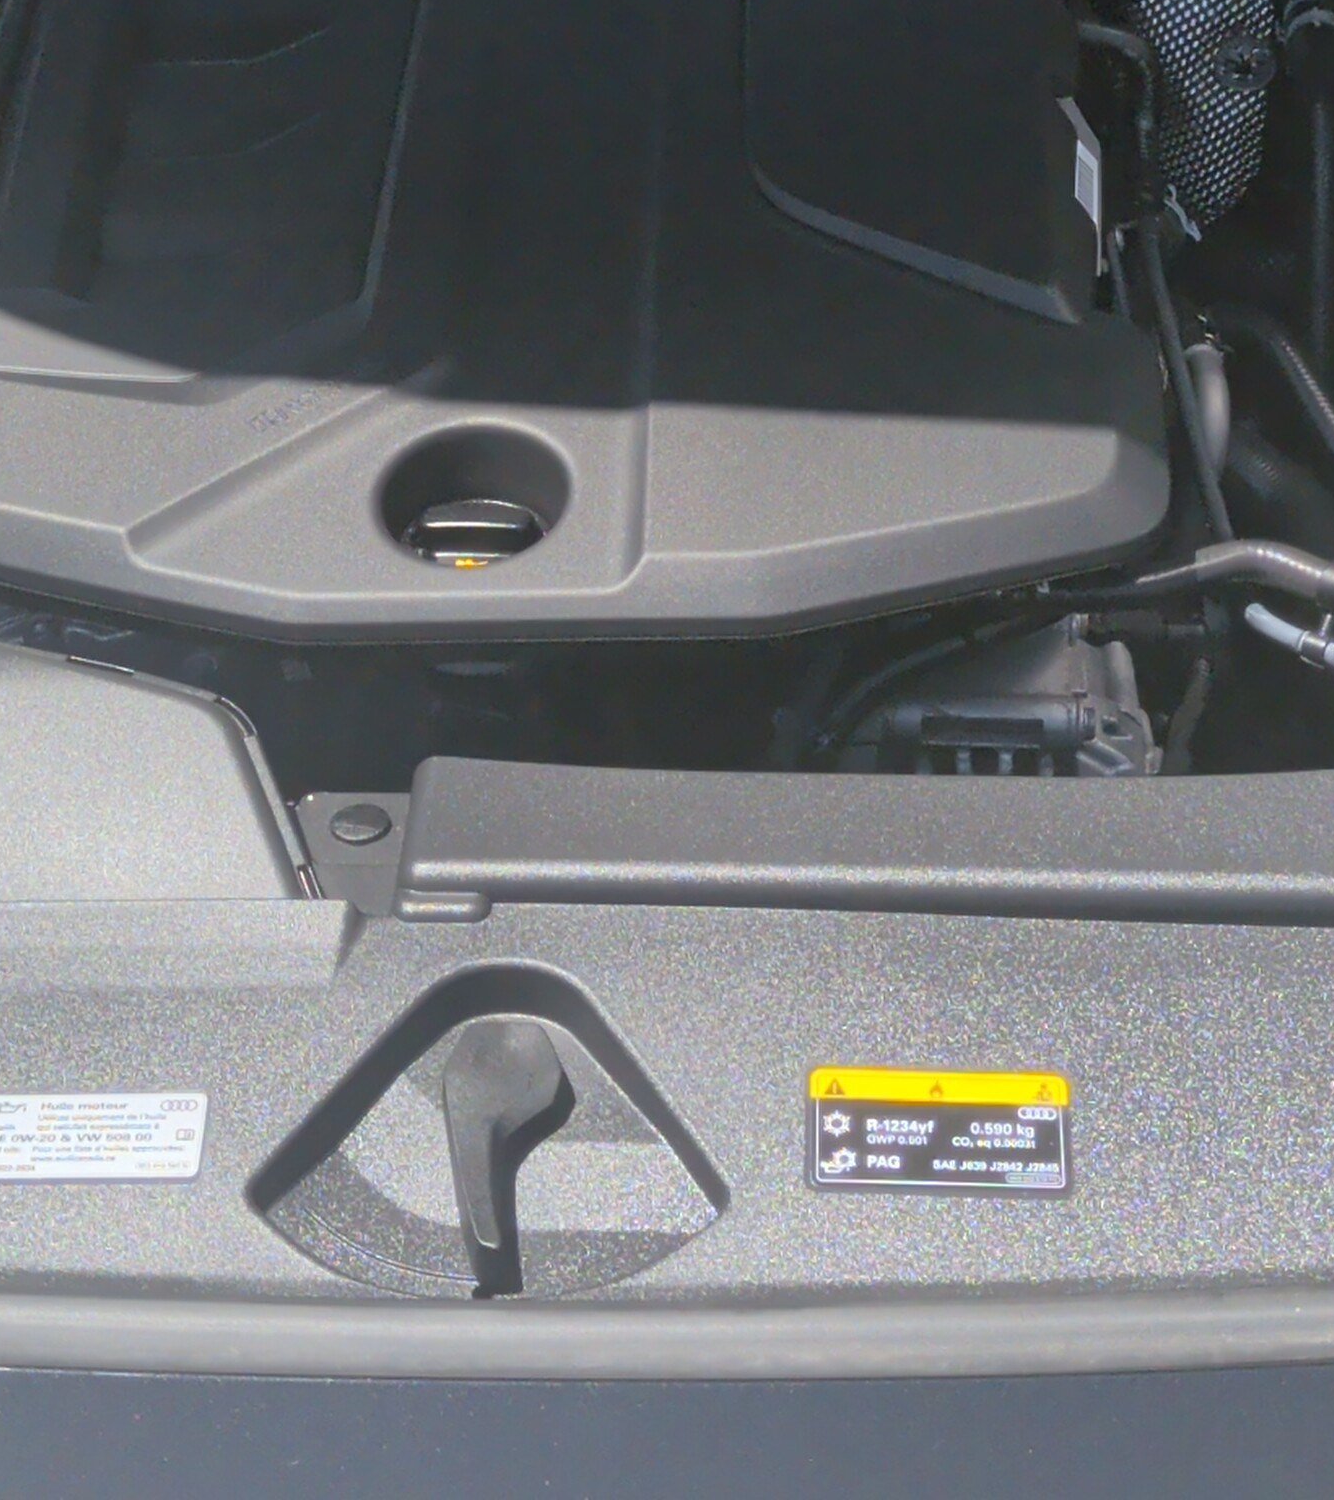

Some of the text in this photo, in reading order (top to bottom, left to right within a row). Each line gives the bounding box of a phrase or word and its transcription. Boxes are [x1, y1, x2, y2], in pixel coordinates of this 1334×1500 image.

[78, 1102, 128, 1110] moteur
[866, 1118, 934, 1135] R-1234yf
[970, 1122, 1035, 1138] 0.590 kg
[11, 1134, 56, 1143] 0W-20
[77, 1133, 102, 1142] VW
[866, 1134, 896, 1145] GWP
[866, 1155, 901, 1169] PAG
[933, 1159, 957, 1170] SAE
